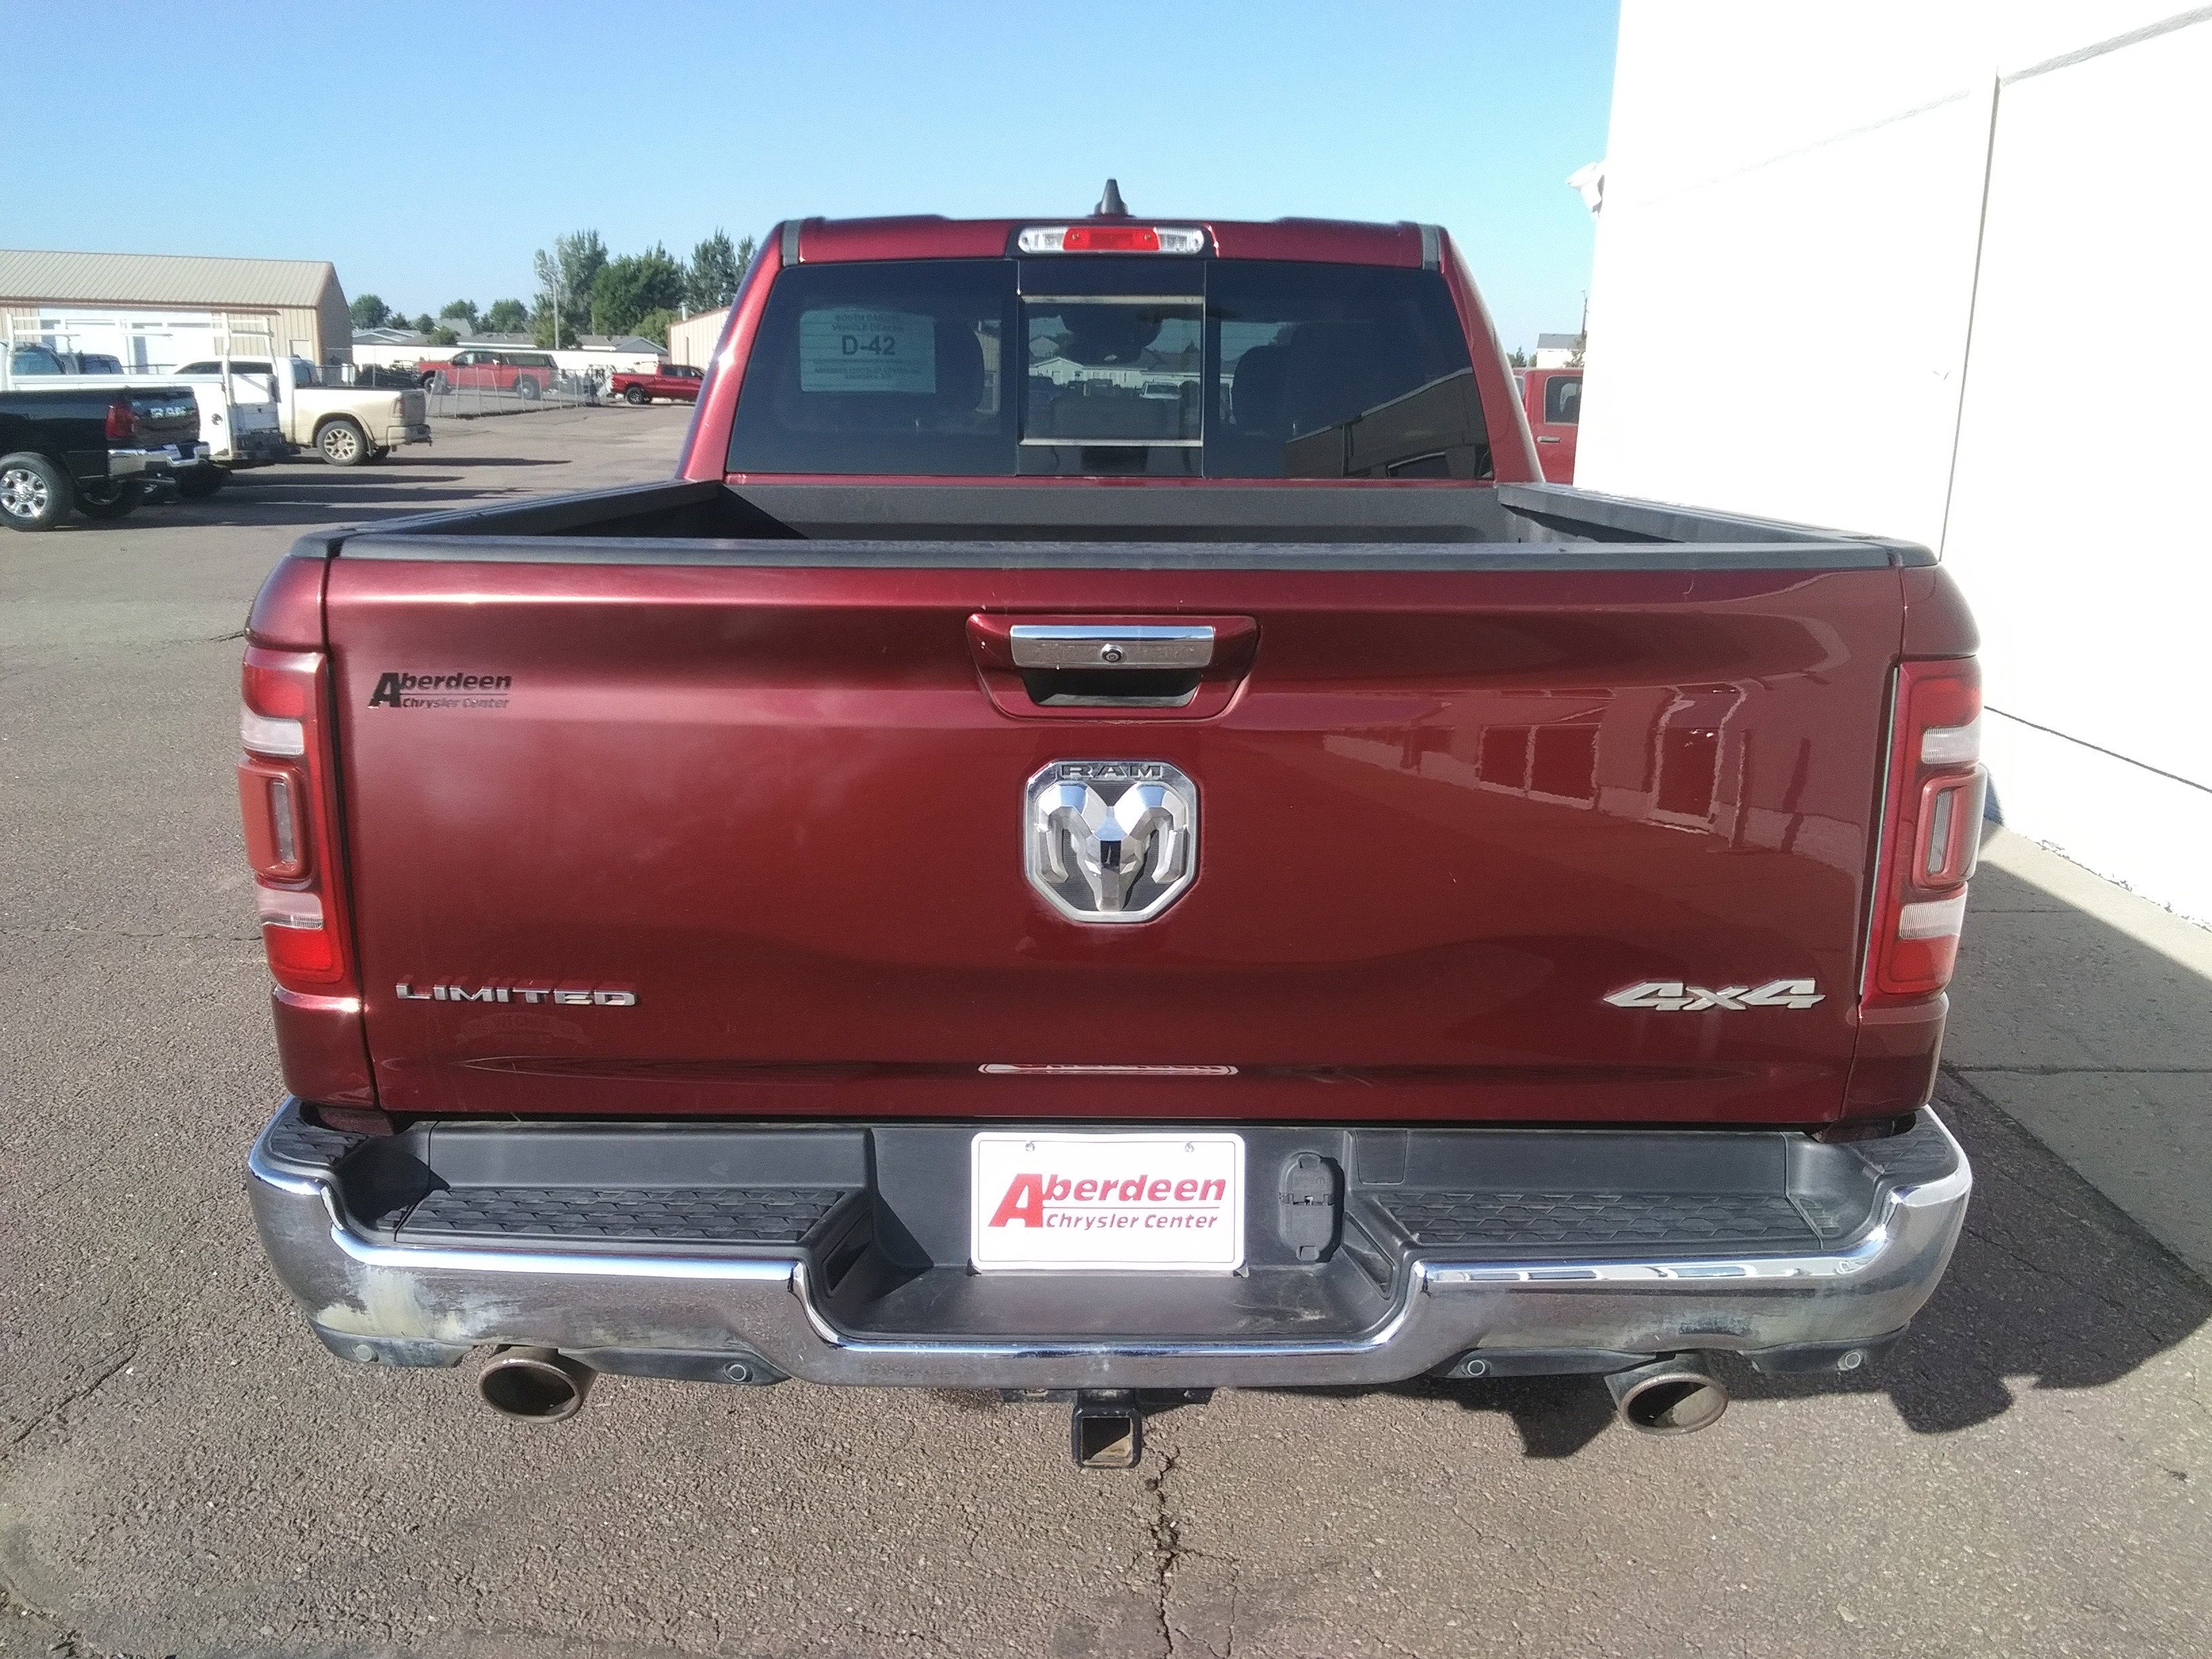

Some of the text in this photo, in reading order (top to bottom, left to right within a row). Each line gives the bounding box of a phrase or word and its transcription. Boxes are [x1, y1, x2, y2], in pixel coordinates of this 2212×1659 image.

[841, 335, 895, 356] D-42
[368, 672, 513, 708] Aberdeen
[403, 697, 508, 709] Chrysler Center
[1061, 765, 1162, 779] RAM
[396, 983, 637, 1006] LIMITED
[988, 1173, 1226, 1228] Aberdeen
[1046, 1213, 1217, 1230] Chrysler Center
